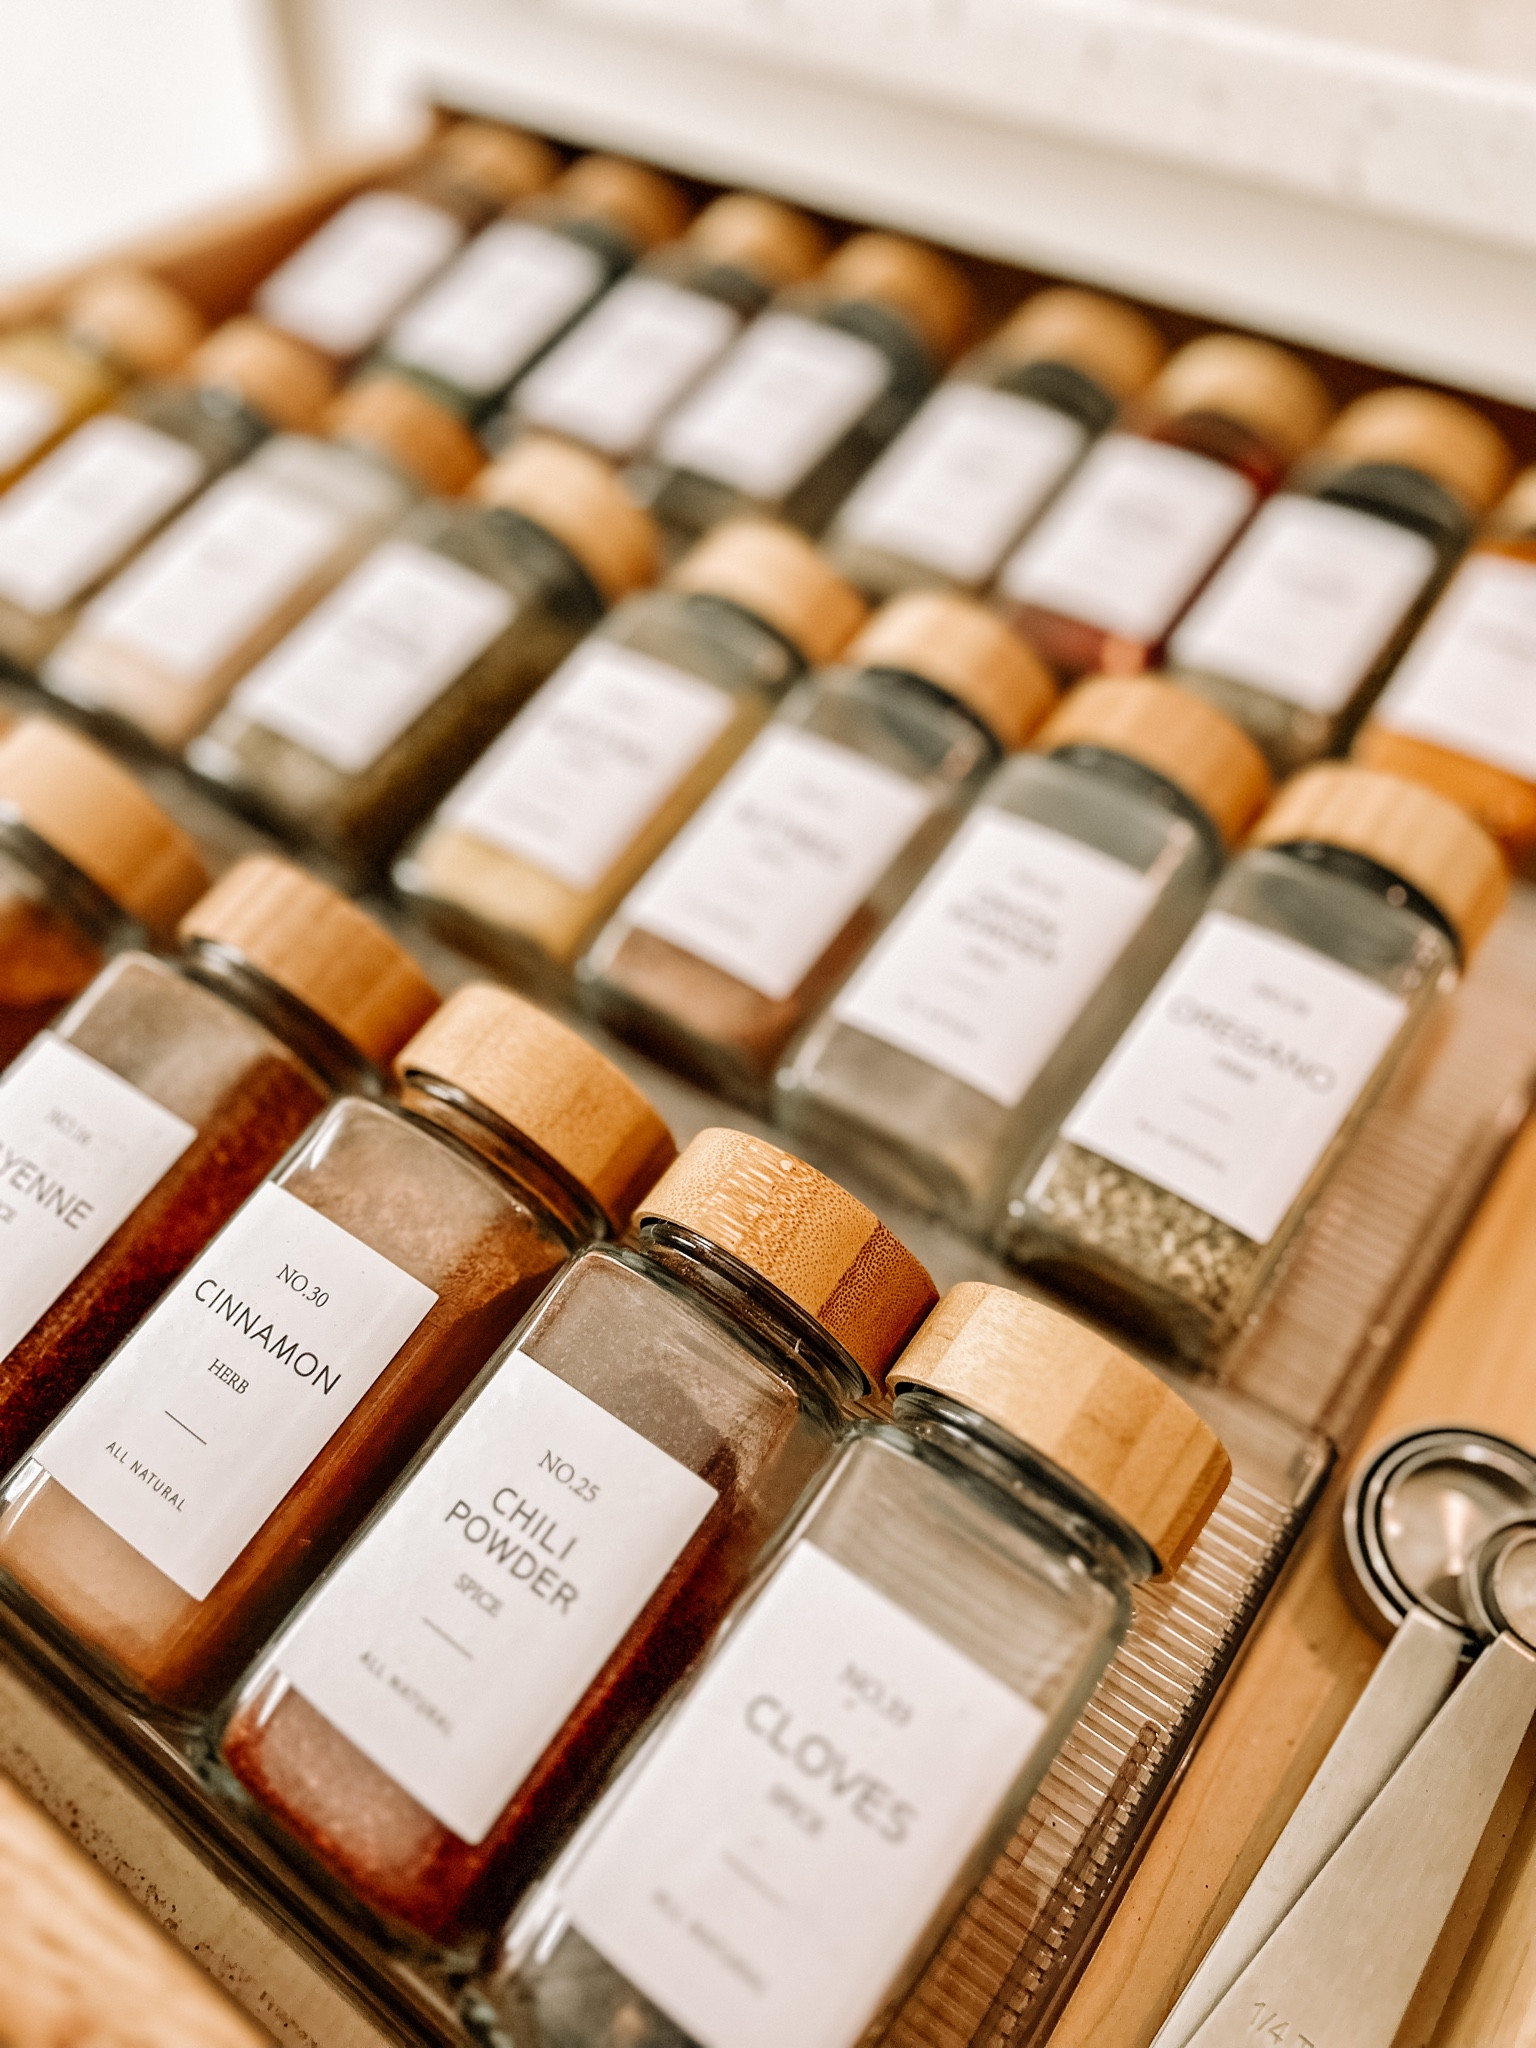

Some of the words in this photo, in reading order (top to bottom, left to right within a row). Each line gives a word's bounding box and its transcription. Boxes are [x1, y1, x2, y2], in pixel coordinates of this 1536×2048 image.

[0, 1144, 95, 1230] YENNE
[276, 1263, 330, 1309] NO.30
[195, 1278, 342, 1396] CINNAMON
[207, 1358, 251, 1396] HERB
[106, 1440, 129, 1465] ALL
[130, 1460, 187, 1513] NATURAL
[537, 1449, 601, 1504] NO.25
[444, 1499, 580, 1617] POWDER
[492, 1486, 578, 1561] CHILI
[454, 1572, 505, 1618] SPICE
[743, 1693, 918, 1847] CLOVES
